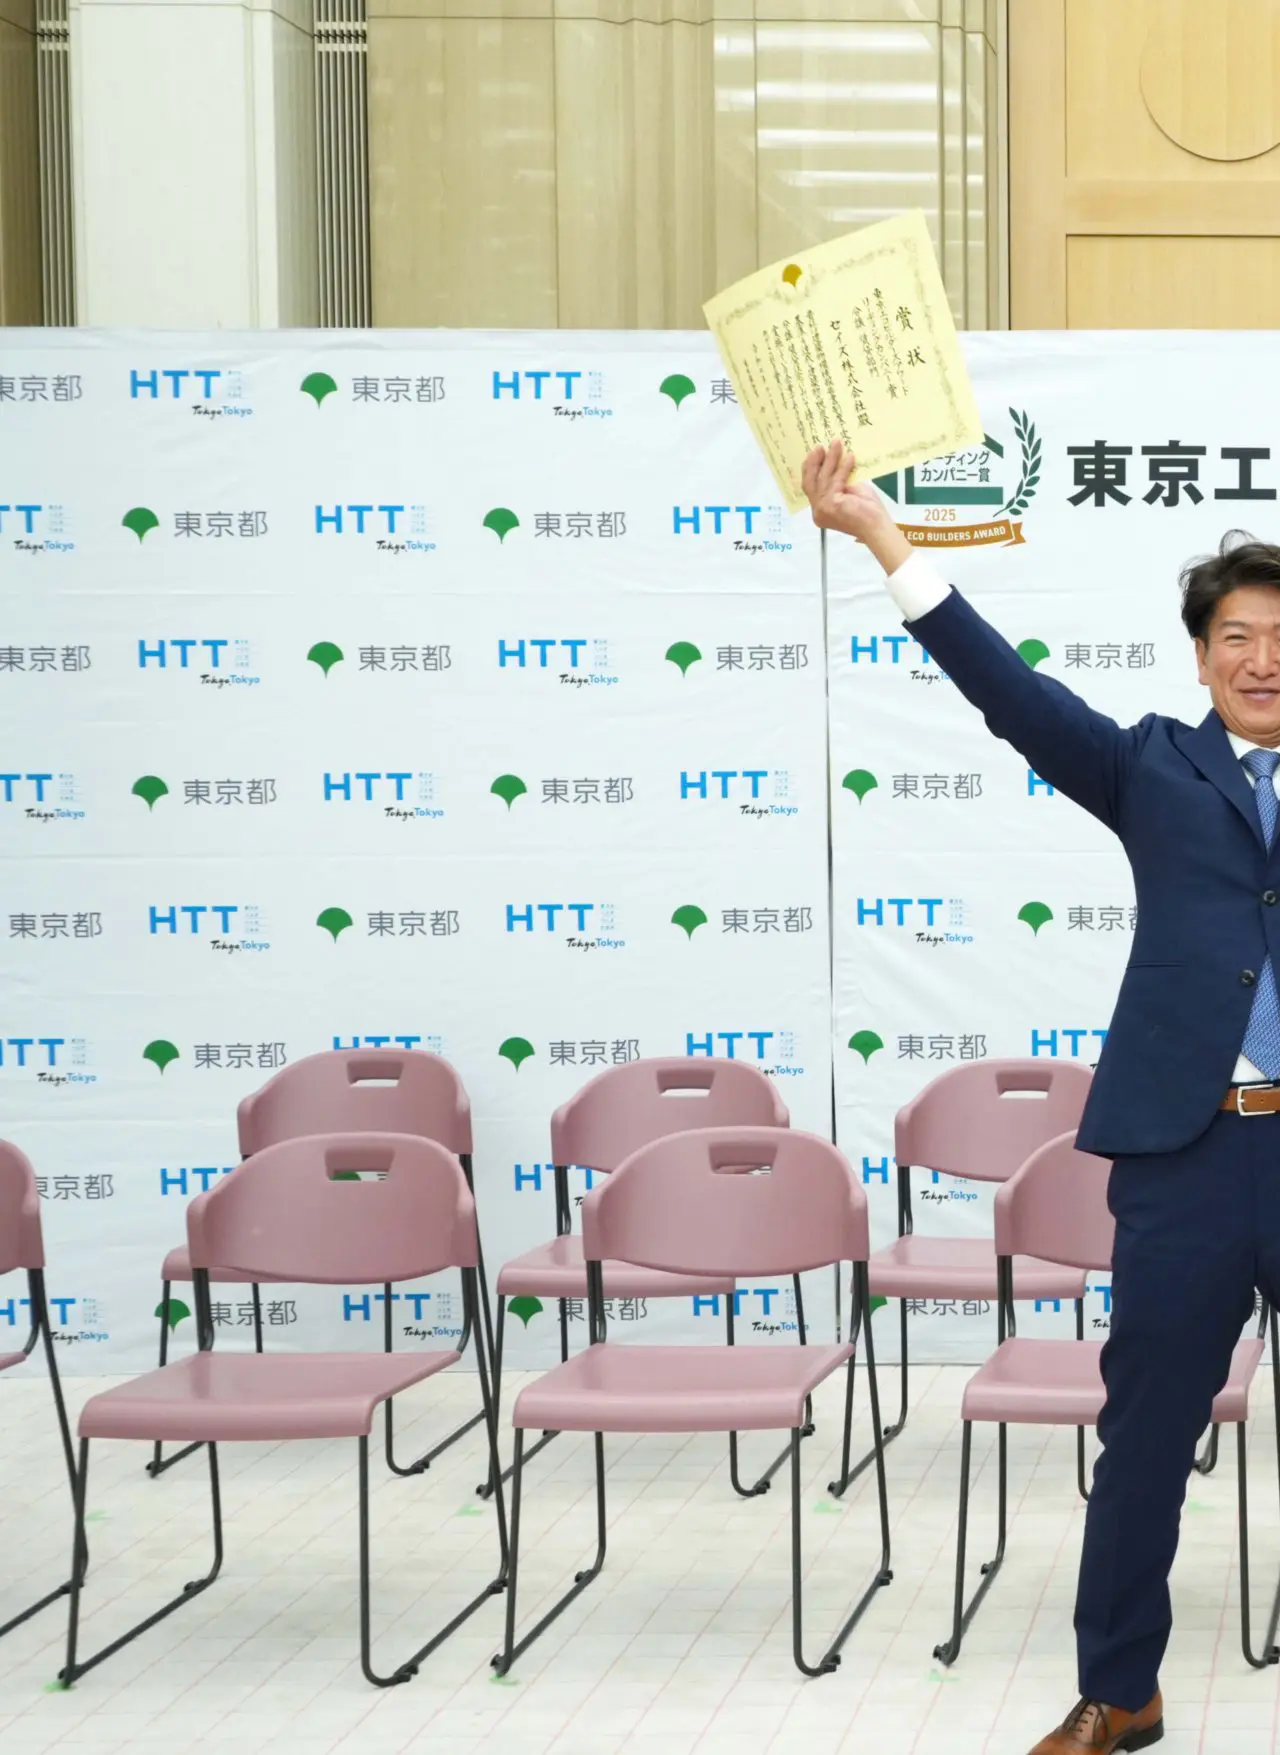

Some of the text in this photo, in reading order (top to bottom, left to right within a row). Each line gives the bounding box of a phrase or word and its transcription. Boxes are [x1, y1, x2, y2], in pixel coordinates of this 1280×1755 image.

[131, 370, 220, 397] HTT
[352, 376, 446, 404] 東京都
[494, 372, 581, 399] HTT
[192, 406, 252, 421] Tokyo Tokyo
[552, 406, 612, 421] Tokyo Tokyo
[922, 450, 991, 467] ーディング
[920, 467, 991, 483] カンパニー賞
[174, 511, 269, 538] 東京都
[316, 506, 404, 533] HTT
[534, 512, 627, 539] 東京都
[674, 506, 760, 534] HTT
[924, 508, 957, 522] 2025
[907, 526, 1006, 542] ECO BUILDERS AWARD
[13, 540, 72, 555] Tokyo Tokyo
[376, 540, 435, 555] Tokyo Tokyo
[733, 540, 792, 555] Tokyo Tokyo
[0, 645, 91, 672] 東京都
[140, 640, 227, 667] HTT
[358, 645, 452, 672] 東京都
[499, 640, 586, 667] HTT
[716, 644, 809, 671] 東京都
[1064, 643, 1156, 669] 東京都
[200, 674, 260, 689] Tokyo Tokyo
[559, 674, 619, 689] Tokyo Tokyo
[910, 670, 939, 685] Tokyo
[183, 779, 278, 806] 東京都
[325, 773, 412, 800] HTT
[541, 777, 634, 804] 東京都
[681, 771, 768, 798] HTT
[892, 773, 983, 800] 東京都
[24, 808, 84, 823] Tokyo Tokyo
[384, 807, 444, 822] Tokyo Tokyo
[739, 805, 798, 820] Tokyo Tokyo
[9, 912, 103, 939] 東京都
[150, 906, 237, 933] HTT
[368, 910, 460, 937] 東京都
[507, 904, 592, 931] HTT
[722, 907, 813, 934] 東京都
[858, 899, 943, 926] HTT
[210, 941, 270, 956] Tokyo Tokyo
[566, 938, 626, 953] Tokyo Tokyo
[915, 932, 974, 947] Tokyo Tokyo
[194, 1043, 287, 1069] 東京都
[549, 1039, 641, 1066] 東京都
[686, 1032, 773, 1058] HTT
[897, 1034, 988, 1061] 東京都
[37, 1072, 97, 1087] Tokyo Tokyo
[775, 1065, 804, 1077] Tokyo
[920, 1190, 979, 1205] Tokyo Tokyo
[80, 1332, 109, 1344] Tokyo
[404, 1326, 434, 1341] Tokyo
[752, 1321, 782, 1336] Tokyo
